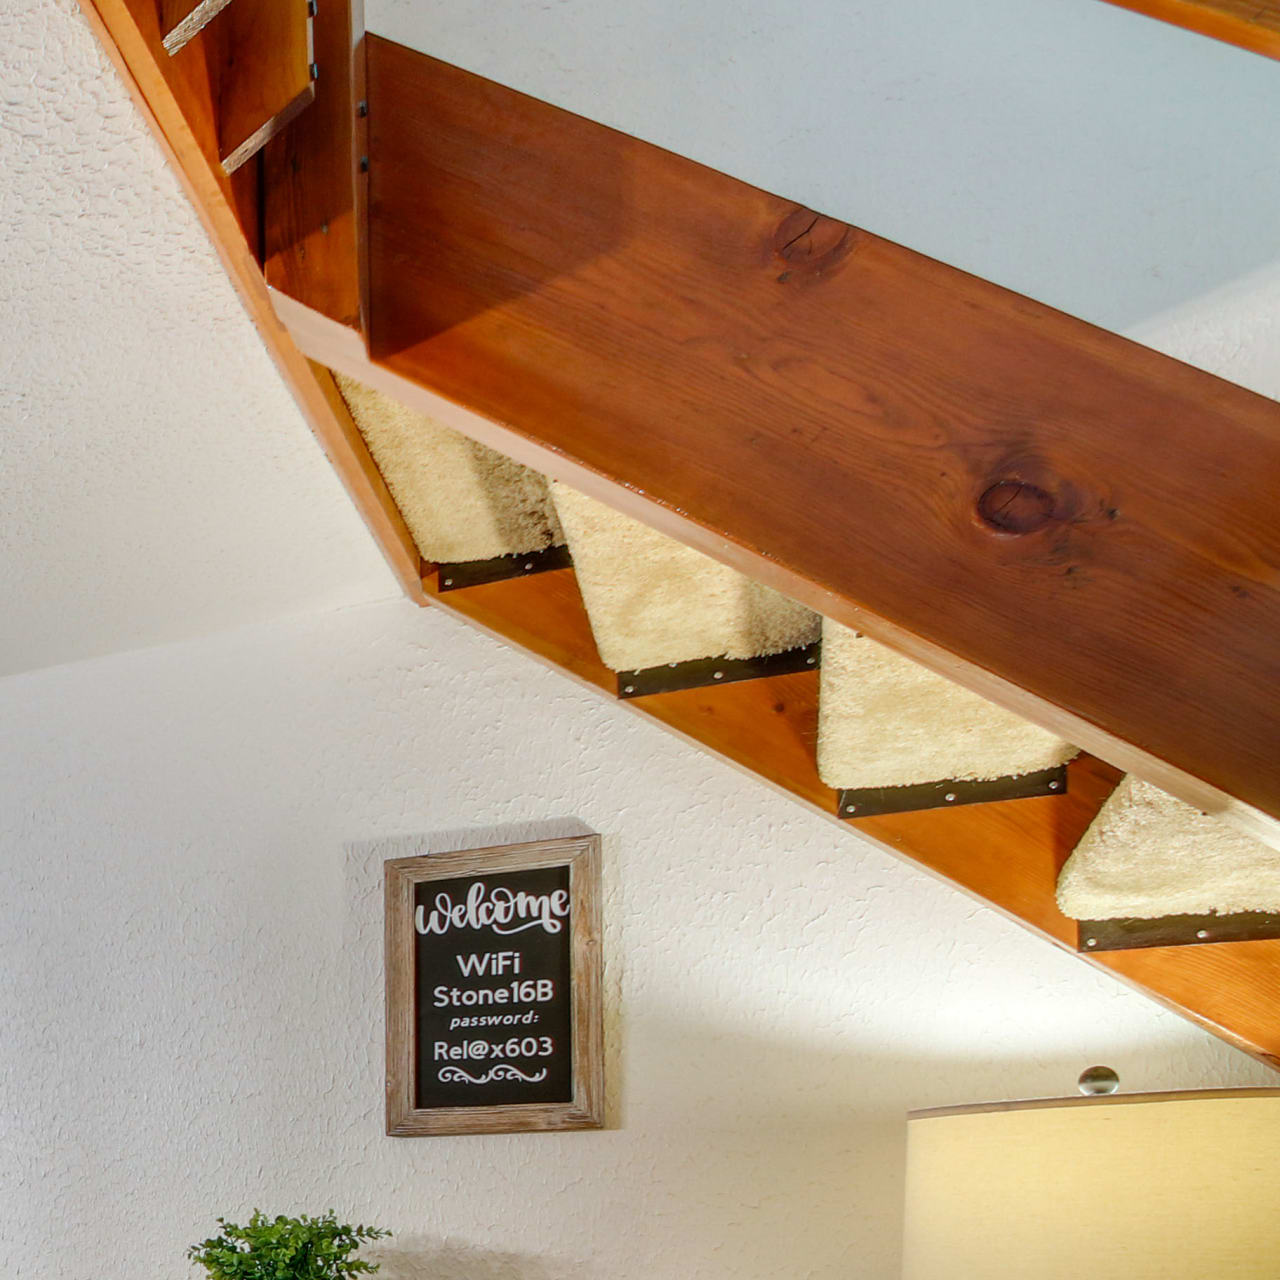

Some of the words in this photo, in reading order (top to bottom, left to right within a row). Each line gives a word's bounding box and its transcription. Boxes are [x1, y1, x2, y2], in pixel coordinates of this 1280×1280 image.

[456, 951, 521, 977] WiFi
[433, 979, 554, 1007] Stone16B
[449, 1010, 539, 1030] password:
[433, 1036, 553, 1061] Rel@x603
